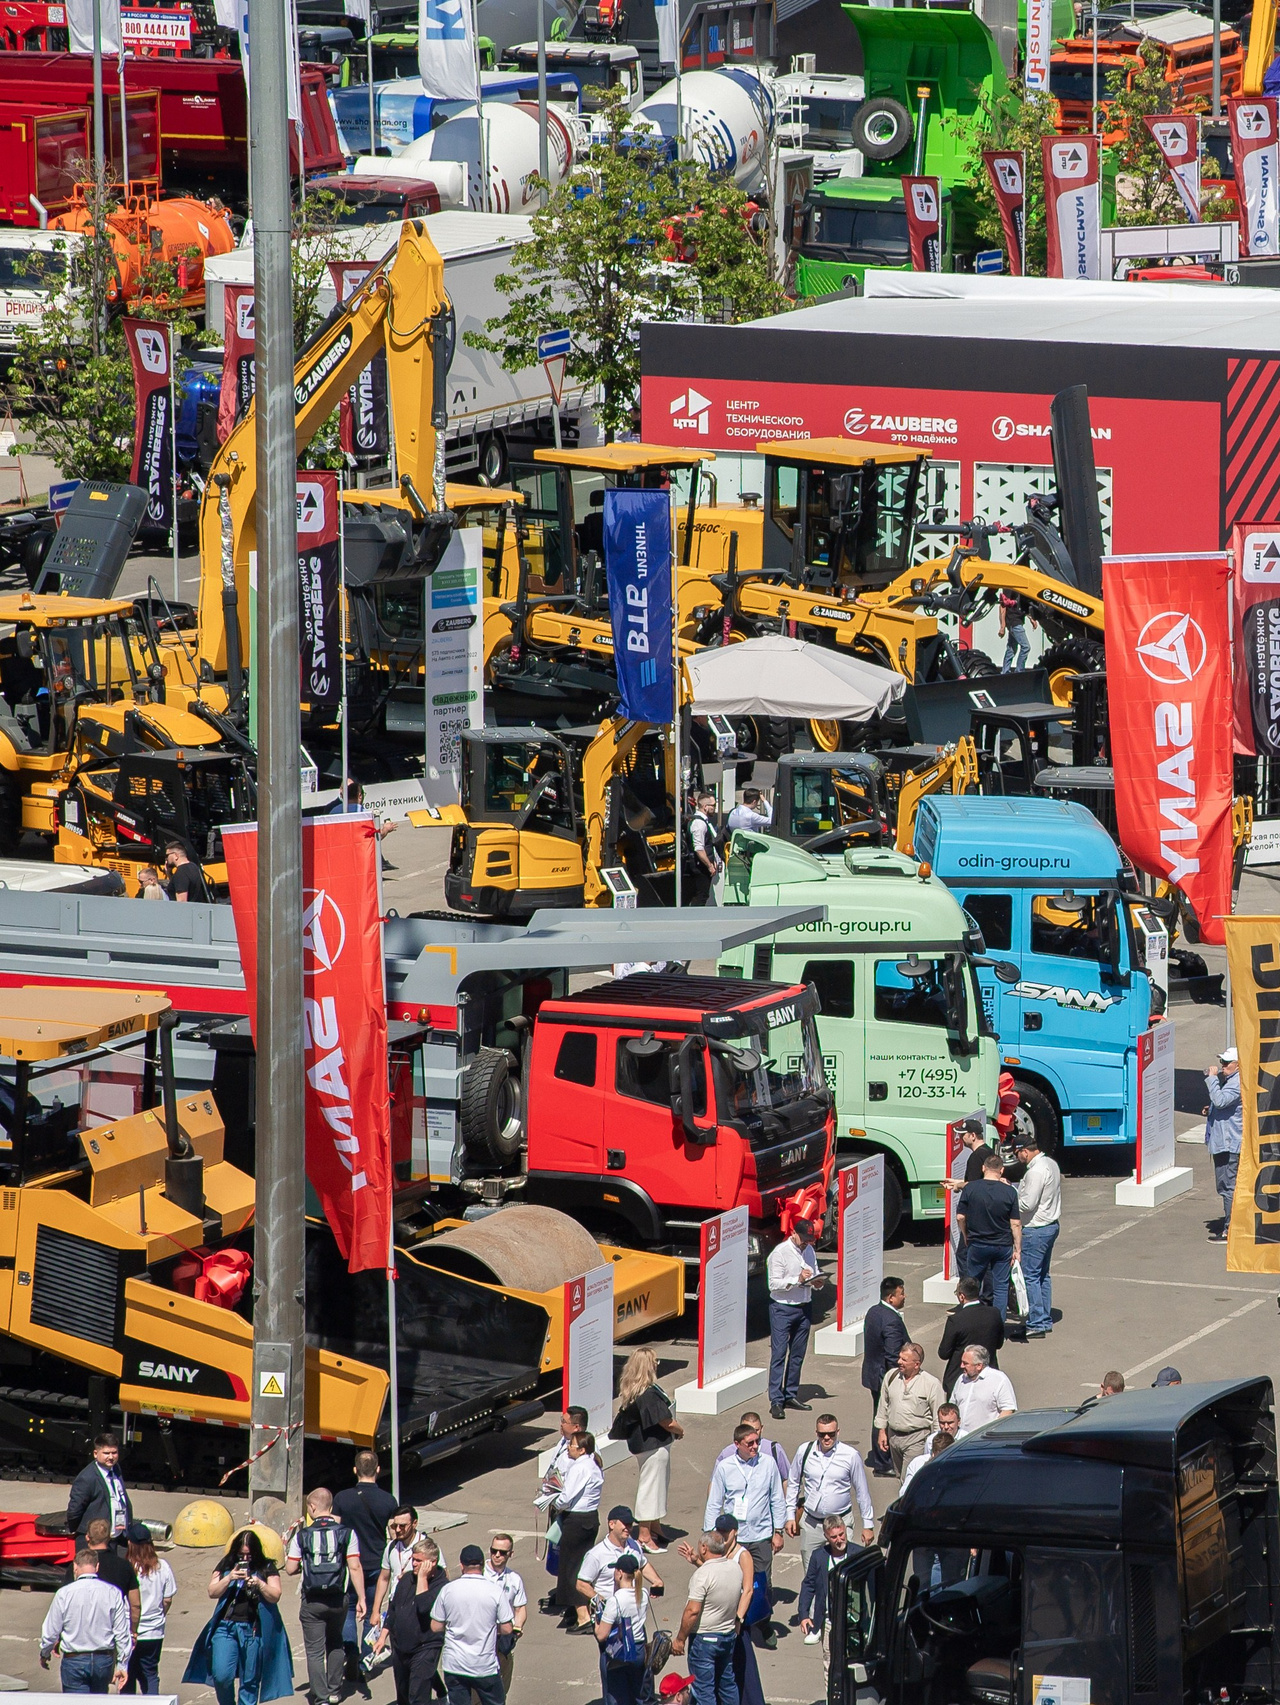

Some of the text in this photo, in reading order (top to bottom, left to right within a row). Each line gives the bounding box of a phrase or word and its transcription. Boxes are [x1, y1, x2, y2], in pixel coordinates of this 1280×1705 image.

[125, 22, 186, 37] 800 4444 174
[334, 119, 408, 129] www.shaman.org
[304, 334, 352, 392] ZAUBERG
[726, 399, 760, 411] ЦЕНТР
[673, 418, 698, 429] ЦТО
[726, 413, 804, 427] ТЕХНИЧЕСКОГО
[870, 415, 958, 434] ZAUBERG
[726, 427, 811, 441] ОБОРУДОВАНИЯ
[890, 433, 958, 446] это надёжно
[1016, 424, 1111, 441] SHAAN
[1051, 594, 1089, 617] ZAUBERG
[821, 608, 851, 621] ZAUBERG
[466, 651, 478, 659] 2022
[432, 690, 477, 705] Надежный
[433, 705, 467, 717] партнер
[387, 793, 424, 806] техники
[957, 853, 1071, 872] odin-group.ru
[795, 919, 911, 936] odin-group.ru
[1005, 981, 1126, 1011] SANY
[766, 1004, 796, 1028] SANY
[107, 1019, 135, 1039] SANY
[868, 1054, 938, 1063] наши контакты
[899, 1067, 959, 1084] +7 (495)
[896, 1085, 967, 1099] 120-33-14
[780, 1143, 808, 1168] SANY
[617, 1291, 651, 1324] SANY
[138, 1361, 200, 1383] SANY
